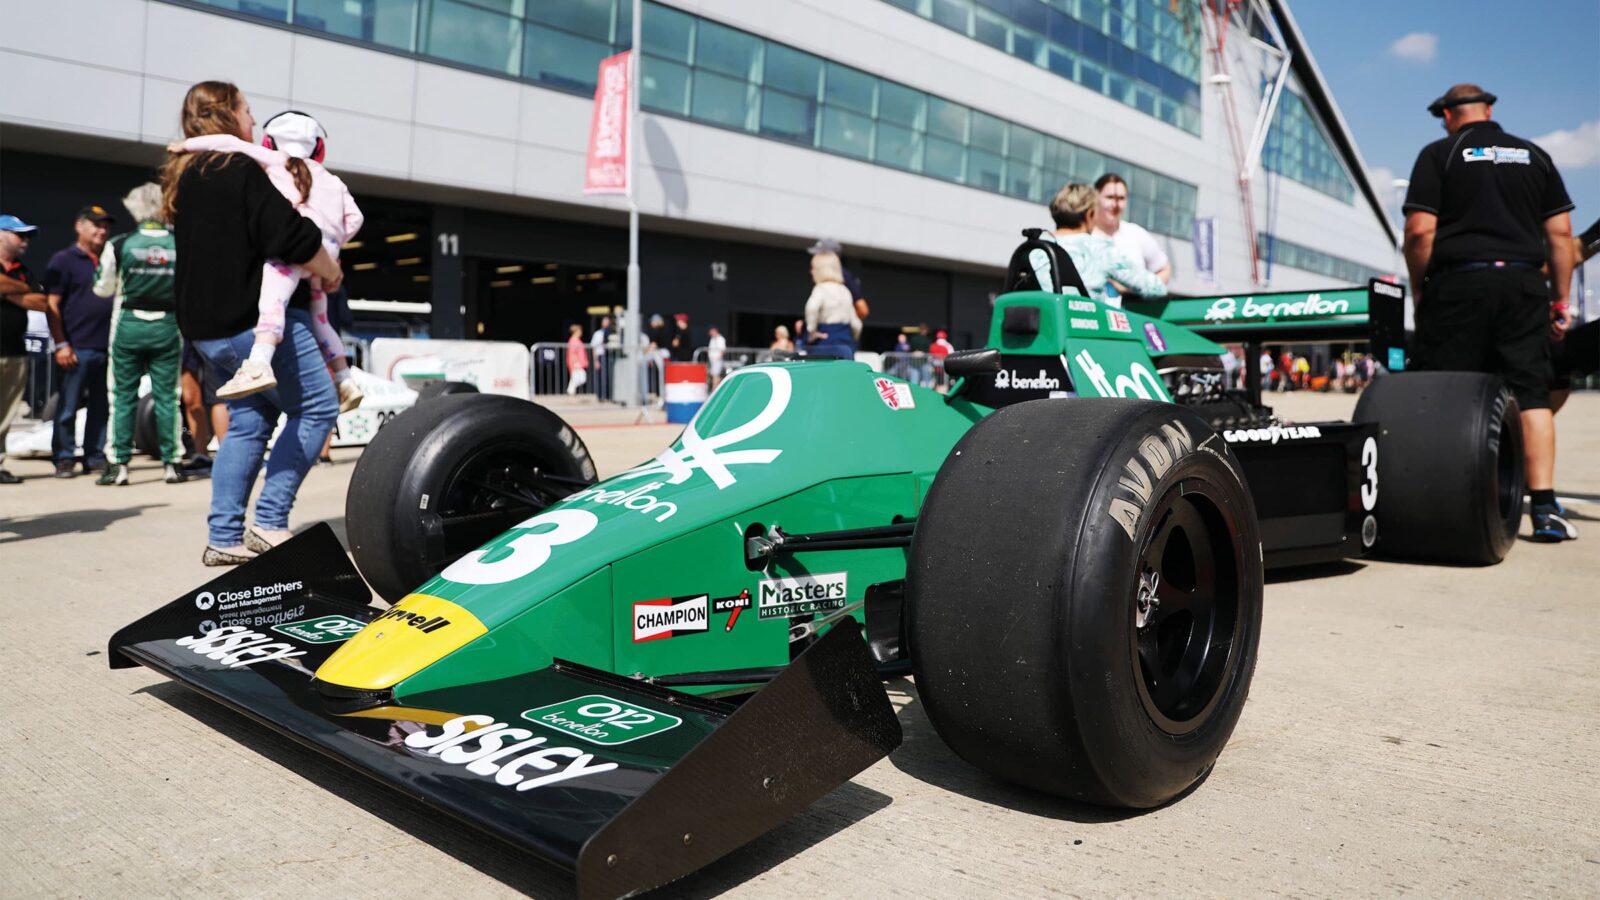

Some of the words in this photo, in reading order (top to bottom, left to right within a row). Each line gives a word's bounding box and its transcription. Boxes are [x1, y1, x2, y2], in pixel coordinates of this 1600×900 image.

[438, 233, 458, 255] 11
[711, 262, 727, 280] 12
[1242, 293, 1349, 318] benetton
[1011, 369, 1060, 390] benetton
[1223, 425, 1321, 445] GOODYEAR
[1108, 419, 1194, 542] AVON
[1361, 436, 1379, 511] 3
[562, 481, 678, 522] enetton
[440, 508, 599, 585] 3
[217, 591, 252, 604] Close
[253, 580, 303, 598] Brothers
[218, 601, 238, 611] Asset
[239, 594, 282, 609] Management
[715, 598, 750, 610] KONI
[761, 582, 844, 606] Masters
[371, 604, 452, 634] yrrell
[636, 606, 706, 630] CHAMPION
[761, 603, 806, 617] HISTORIC
[809, 599, 845, 612] RACING
[175, 625, 308, 669] SISLEY
[541, 710, 610, 740] benetton
[404, 714, 619, 792] SISLEY
